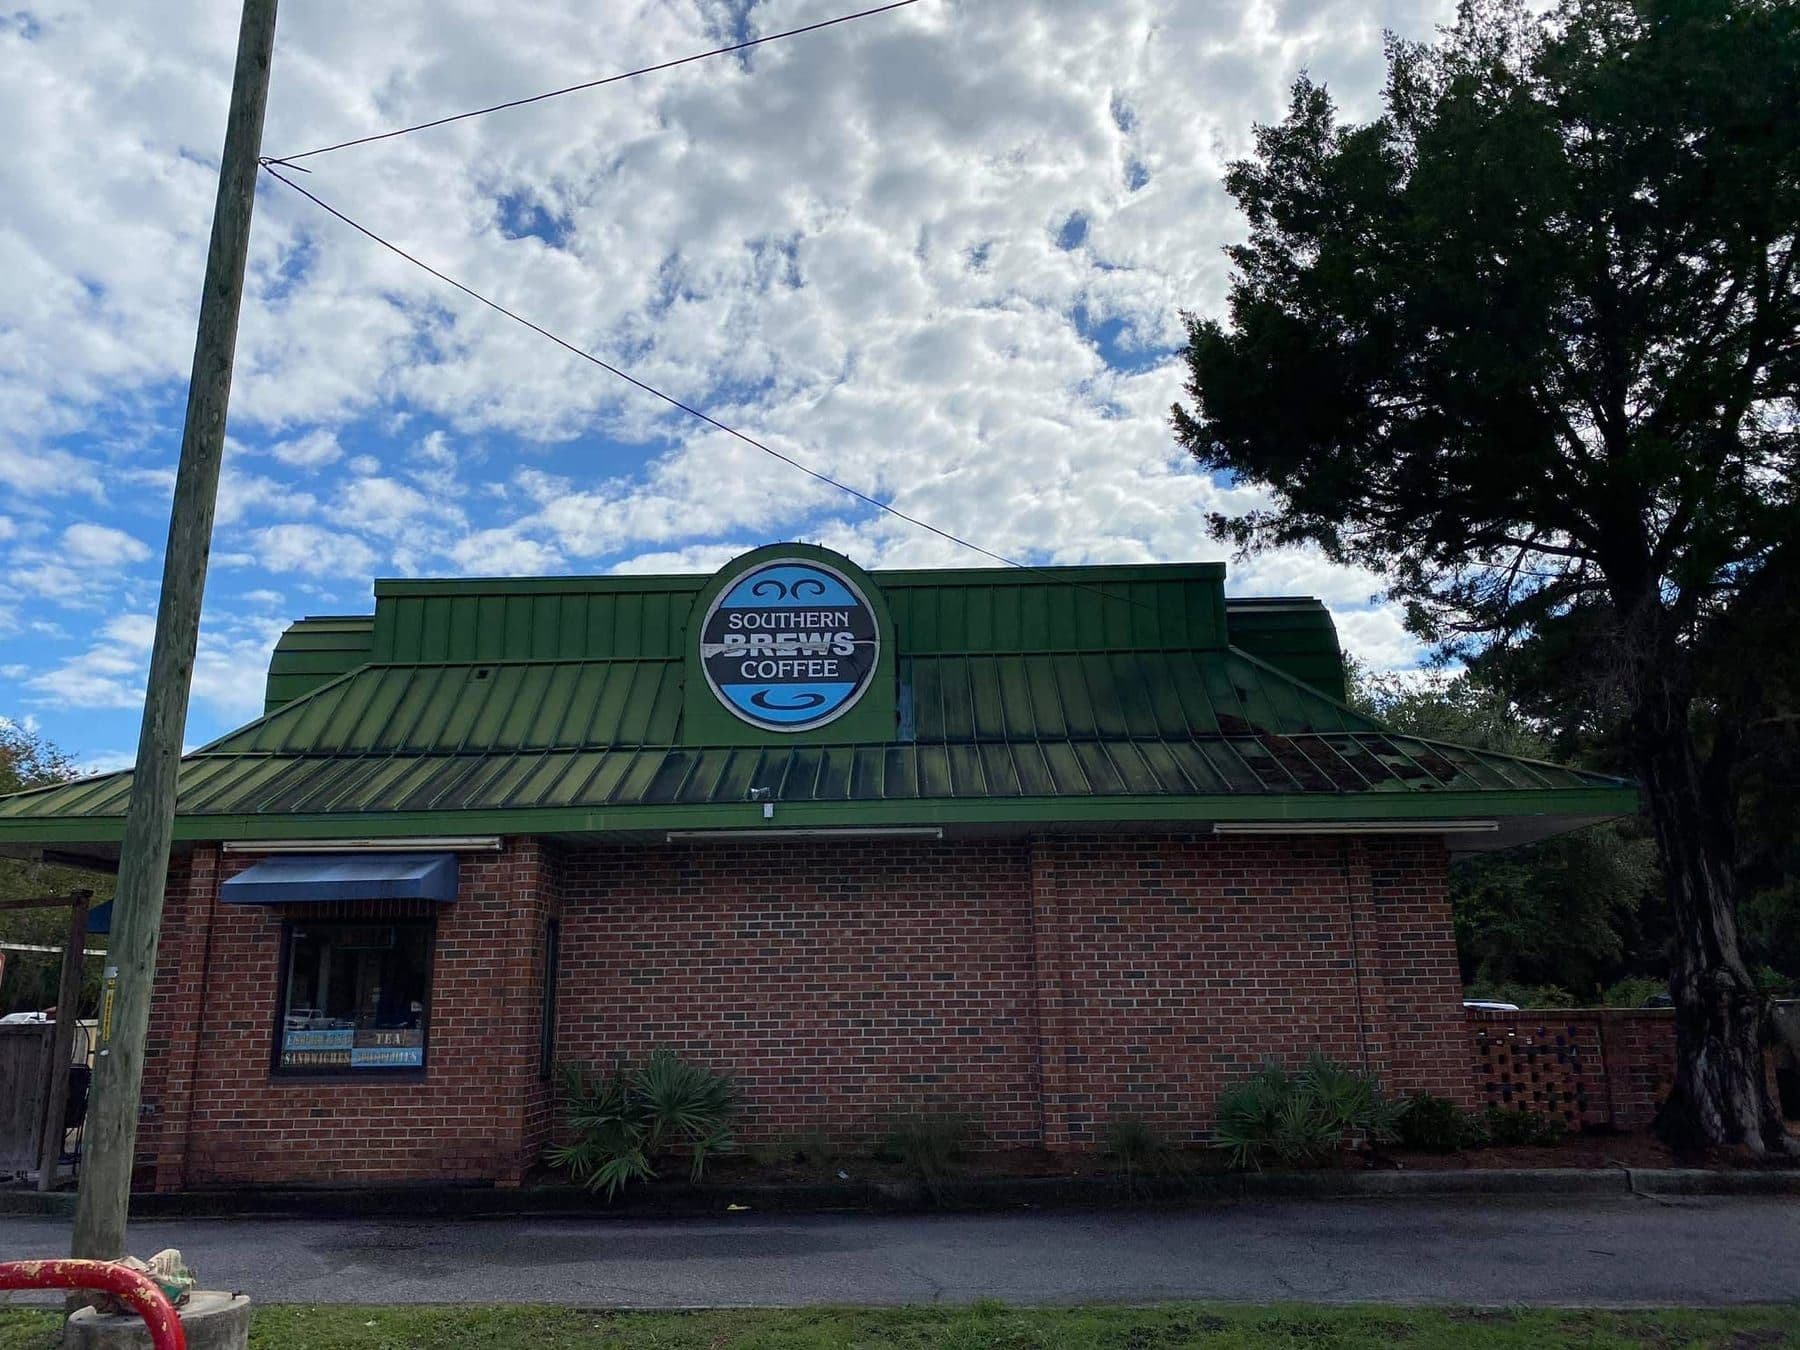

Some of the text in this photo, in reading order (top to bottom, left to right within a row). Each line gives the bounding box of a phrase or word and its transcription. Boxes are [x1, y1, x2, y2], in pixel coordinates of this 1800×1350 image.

[728, 612, 849, 629] SOUTHERN
[723, 631, 855, 658] BREWS
[741, 660, 839, 679] COFFEE
[375, 1033, 401, 1046] TEA
